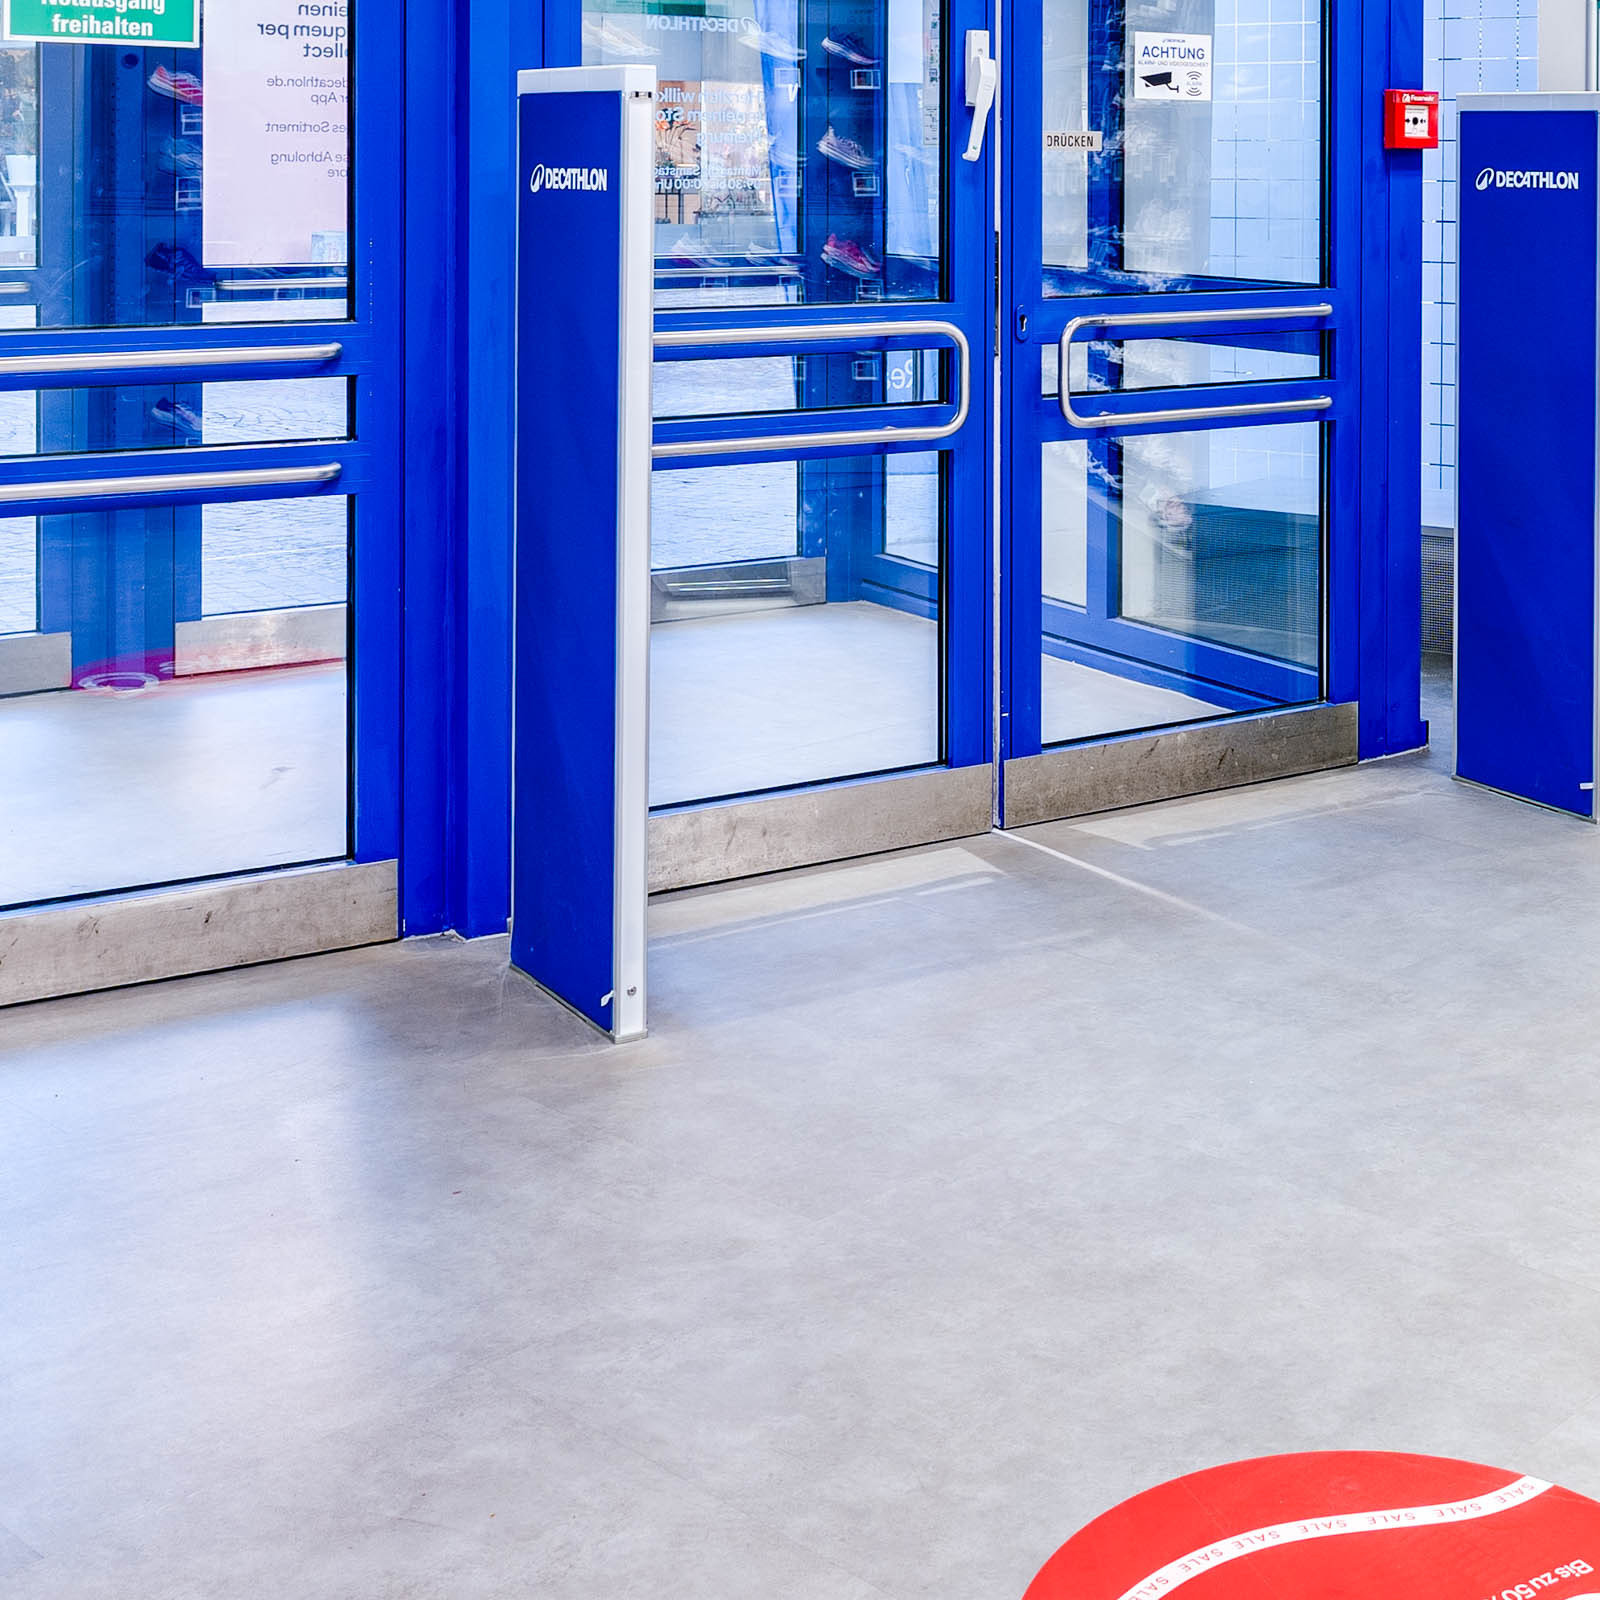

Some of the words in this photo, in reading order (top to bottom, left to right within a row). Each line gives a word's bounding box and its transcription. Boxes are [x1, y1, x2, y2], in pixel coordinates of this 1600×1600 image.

[51, 13, 154, 37] freihalten
[1142, 45, 1205, 60] ACHTUNG
[1046, 132, 1094, 148] DRÜCKEN
[544, 167, 607, 191] DECATHLON
[1495, 170, 1579, 190] DECATHLON
[1497, 1482, 1535, 1504] SALE
[1368, 1512, 1416, 1526] SALE
[1432, 1503, 1483, 1518] SALE
[1299, 1519, 1348, 1534] SALE
[1231, 1530, 1281, 1550] SALE
[1177, 1548, 1224, 1572] SALE
[1554, 1559, 1595, 1578] Bis
[1529, 1572, 1559, 1590] zu
